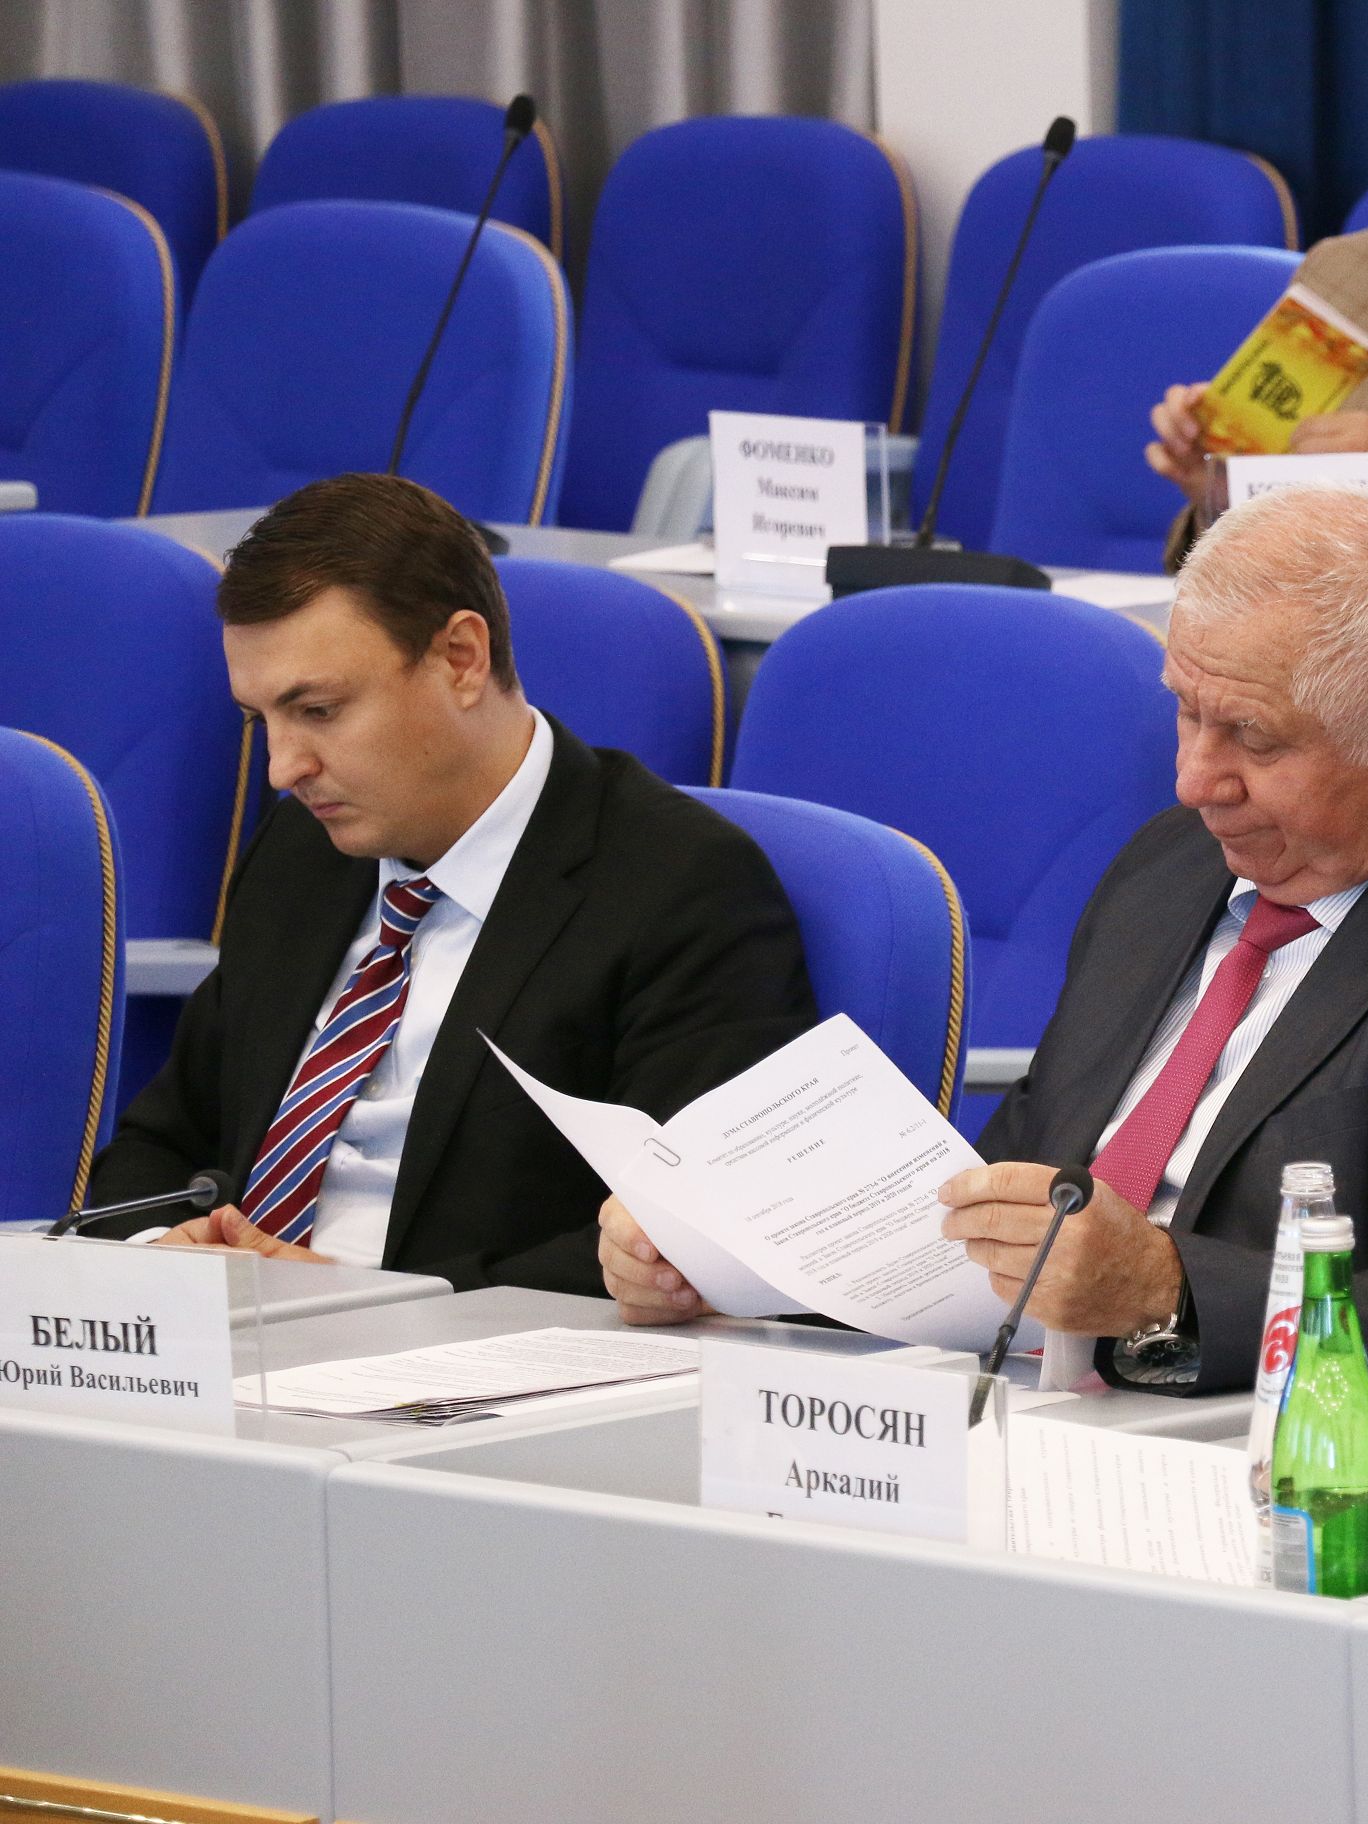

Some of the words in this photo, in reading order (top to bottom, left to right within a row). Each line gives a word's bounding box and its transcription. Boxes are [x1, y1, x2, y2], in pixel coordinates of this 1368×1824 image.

[739, 440, 835, 466] ФОМЕНКО
[800, 1076, 819, 1092] КРАЯ
[30, 1314, 159, 1356] БЕЛЫЙ
[0, 1359, 62, 1390] Юрий
[70, 1365, 200, 1398] Васильевич
[759, 1389, 927, 1448] ТОРОСЯН
[785, 1458, 901, 1504] Аркадий
